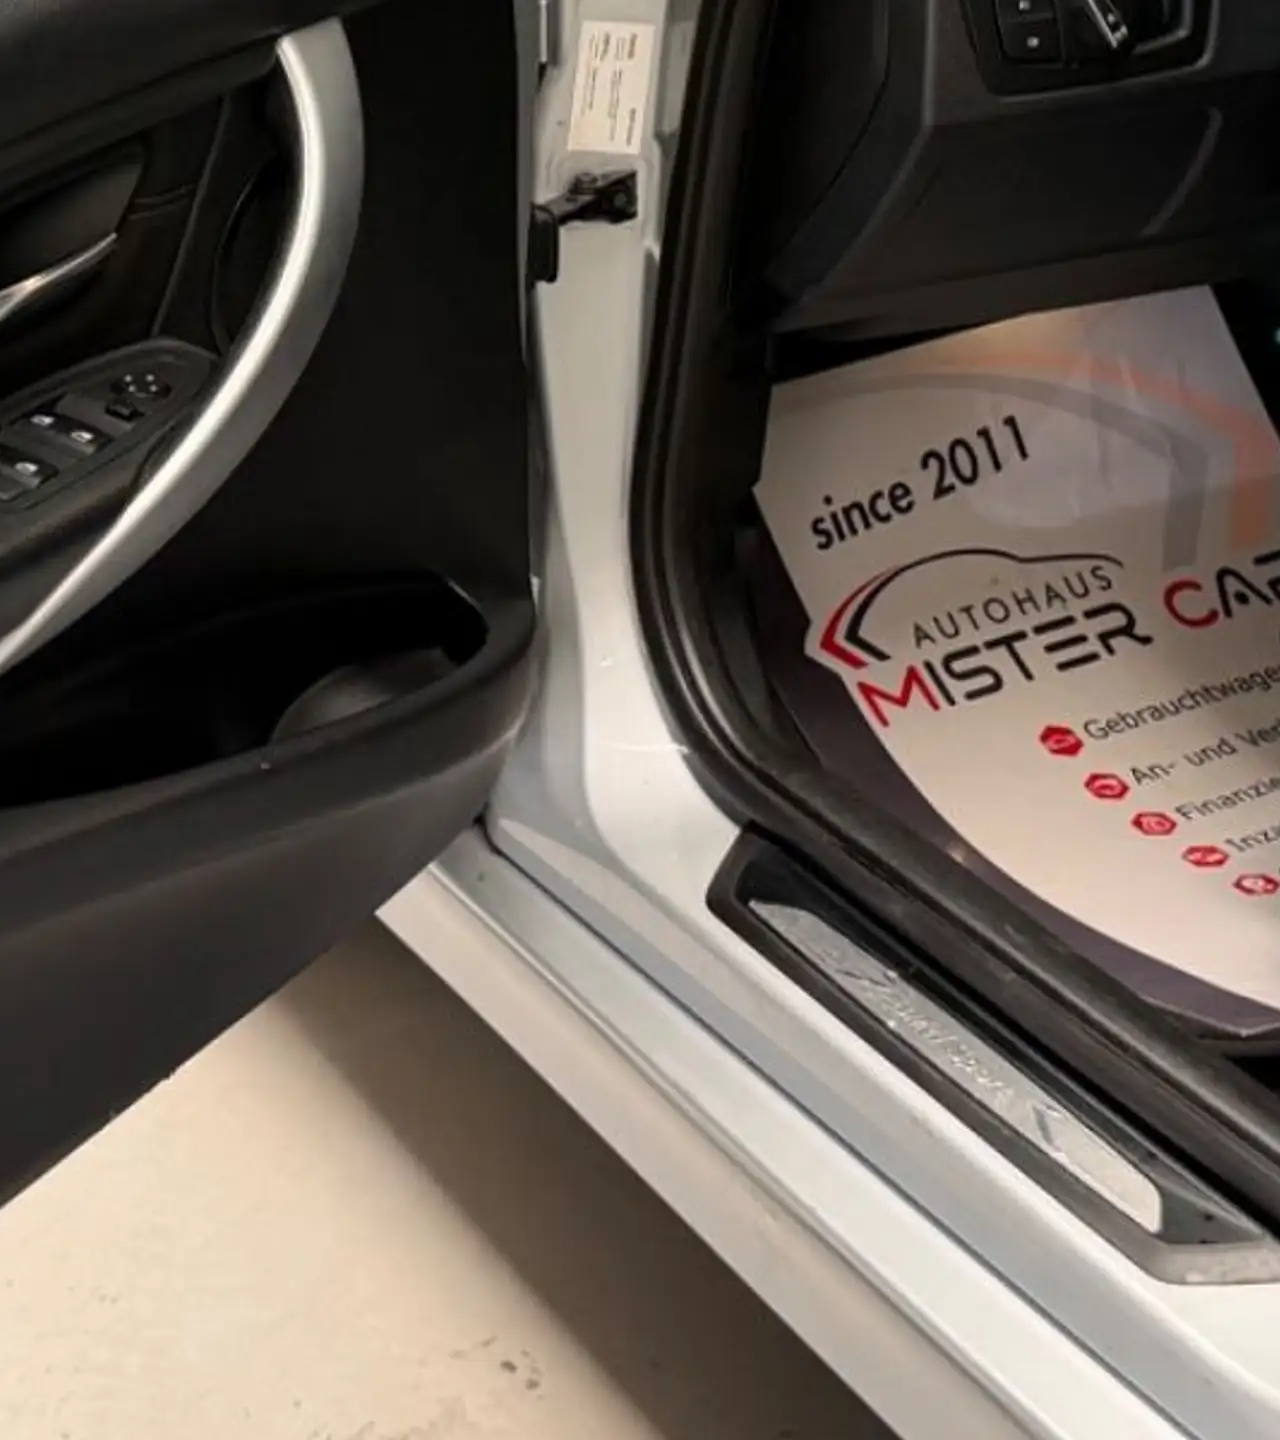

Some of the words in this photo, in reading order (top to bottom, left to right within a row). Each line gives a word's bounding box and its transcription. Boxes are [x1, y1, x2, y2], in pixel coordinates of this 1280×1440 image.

[811, 481, 916, 551] since
[919, 415, 1029, 501] 2011
[911, 564, 1113, 650] AUTOHAUS
[856, 601, 1154, 728] MISTER
[1129, 761, 1177, 787] An-
[1182, 737, 1238, 768] und
